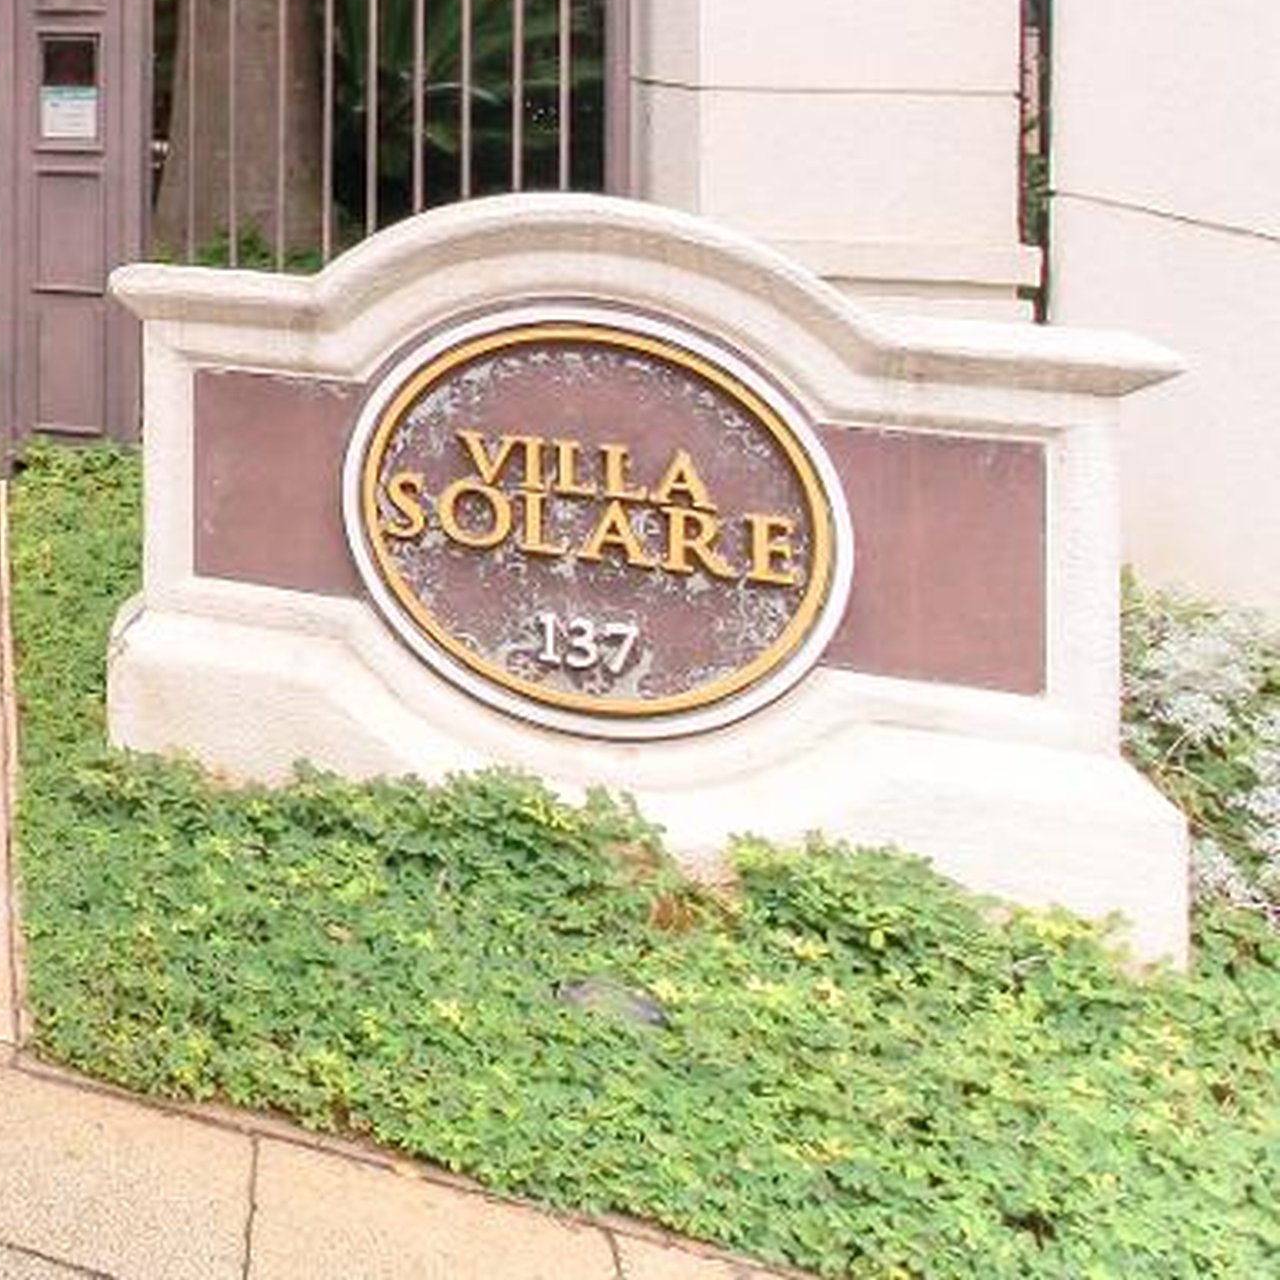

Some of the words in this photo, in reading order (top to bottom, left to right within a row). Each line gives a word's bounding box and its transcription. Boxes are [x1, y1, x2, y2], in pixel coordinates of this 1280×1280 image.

[458, 430, 716, 510] VILLA
[381, 471, 796, 586] SOLARE
[539, 613, 638, 673] 137
